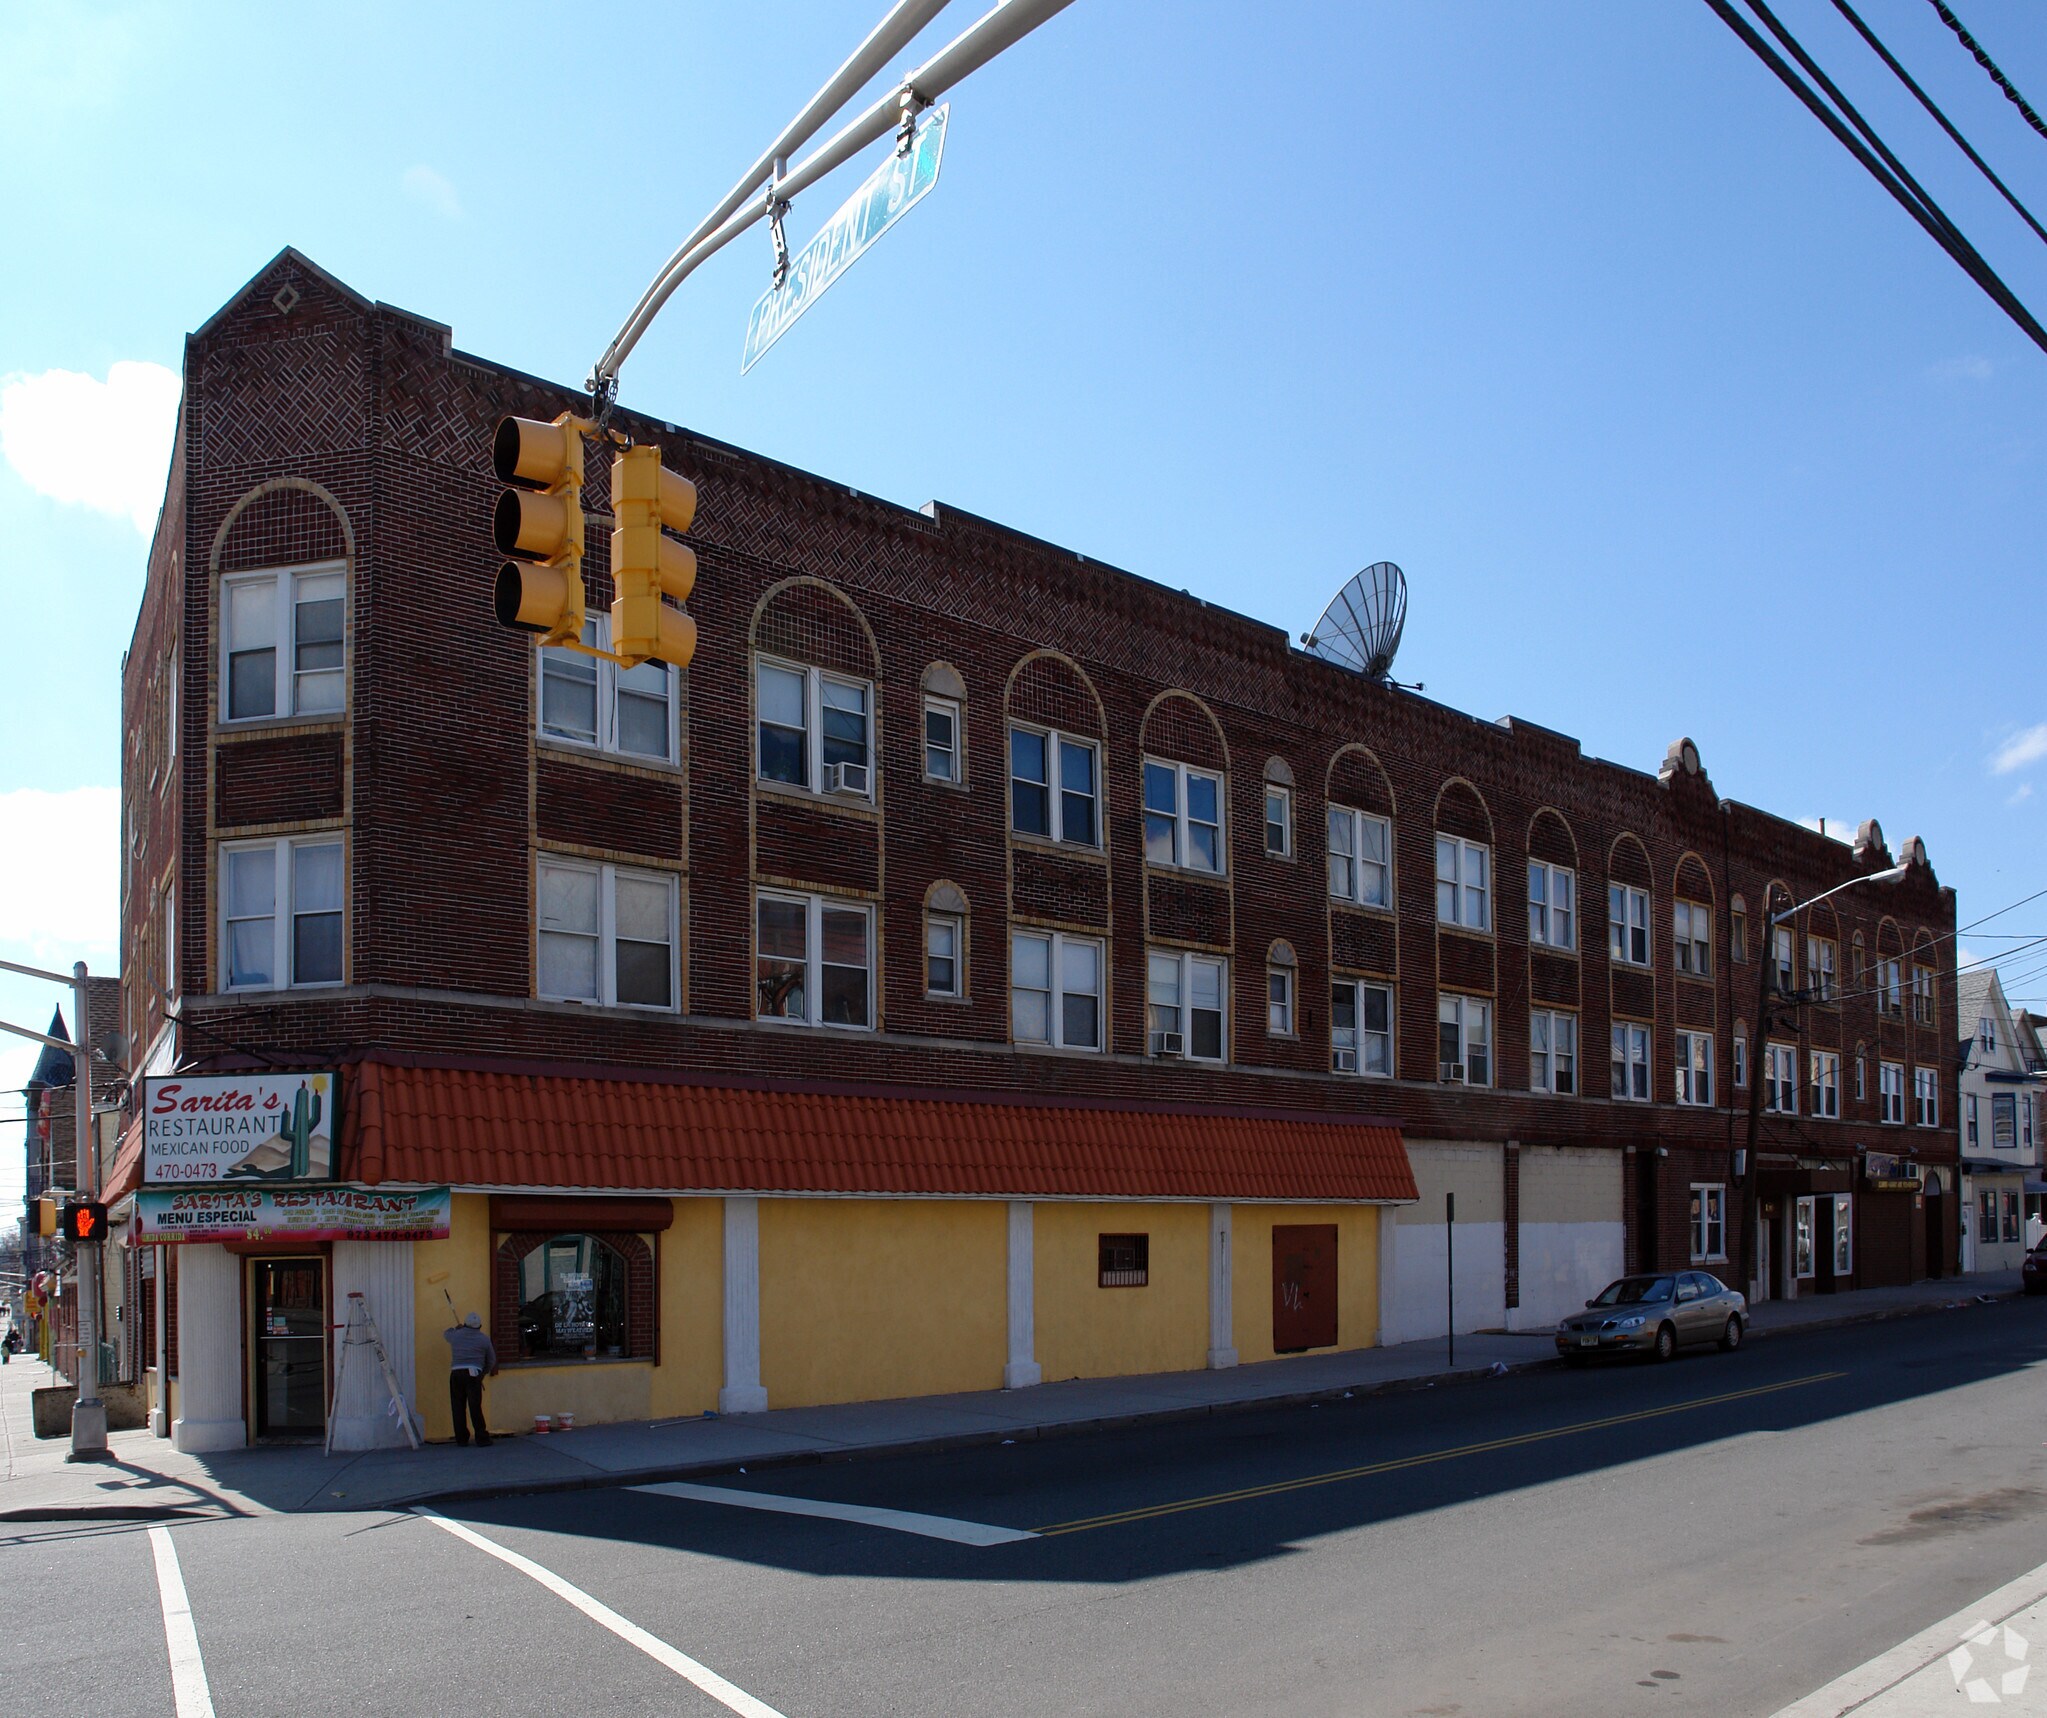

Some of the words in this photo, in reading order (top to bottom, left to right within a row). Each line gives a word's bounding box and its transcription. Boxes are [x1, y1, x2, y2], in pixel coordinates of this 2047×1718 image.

[752, 184, 879, 353] PRESIDENT
[886, 131, 928, 214] ST
[152, 1084, 280, 1114] Sarita's
[149, 1115, 280, 1137] RESTAURANT
[151, 1141, 208, 1156] MEXICAN
[213, 1140, 249, 1154] FOOD
[155, 1163, 217, 1179] 470-0473
[172, 1190, 262, 1210] SARITA'S
[271, 1190, 418, 1213] RESTAURANT
[157, 1212, 193, 1225] MENU
[197, 1210, 257, 1223] ESPECIAL
[160, 1232, 185, 1242] CORRIDA
[347, 1230, 370, 1240] 973
[375, 1230, 433, 1240] 470-0473
